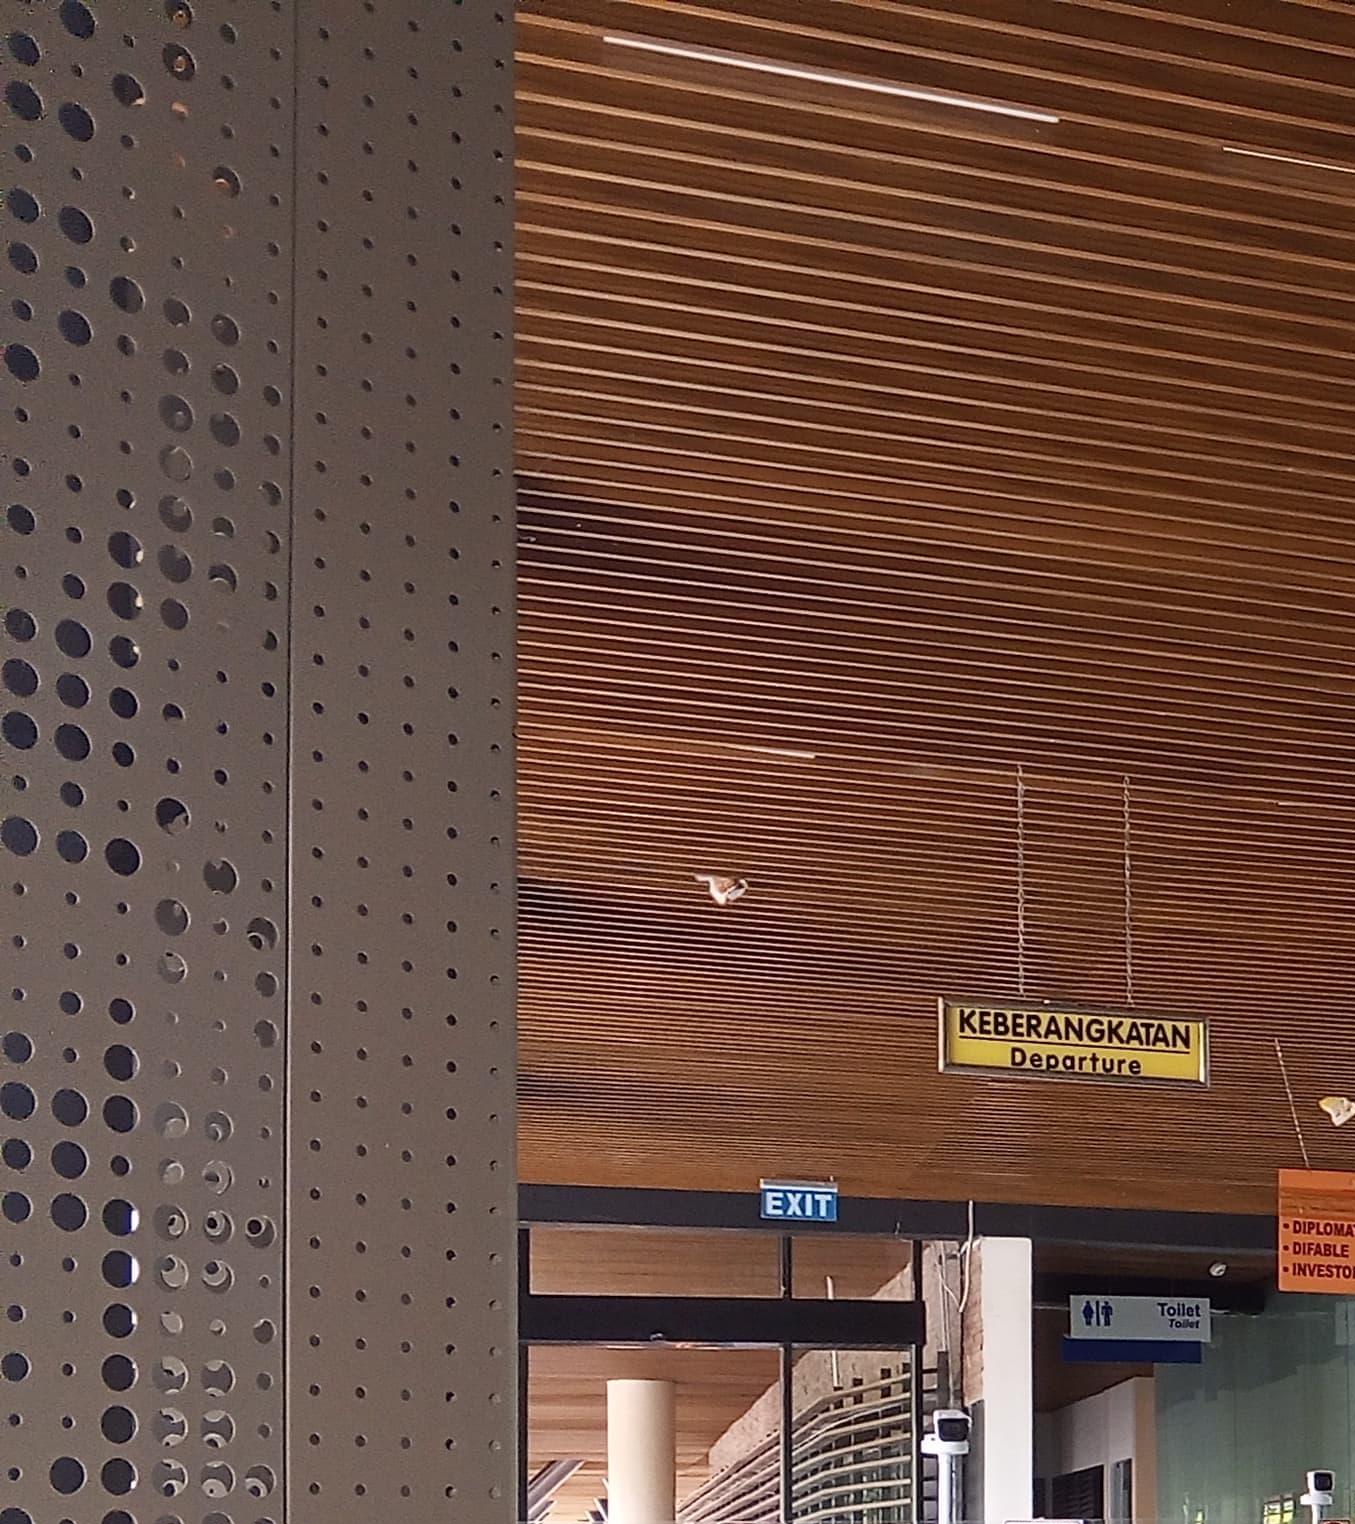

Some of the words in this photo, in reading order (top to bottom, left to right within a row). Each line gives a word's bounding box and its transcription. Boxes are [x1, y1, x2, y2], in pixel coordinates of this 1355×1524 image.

[959, 1009, 1191, 1049] KEBERANGKATAN
[1011, 1047, 1142, 1075] Departure
[766, 1192, 832, 1216] EXIT
[1293, 1242, 1349, 1258] DIFABLE
[1157, 1303, 1201, 1317] Toilet
[1169, 1318, 1200, 1329] Toilet
